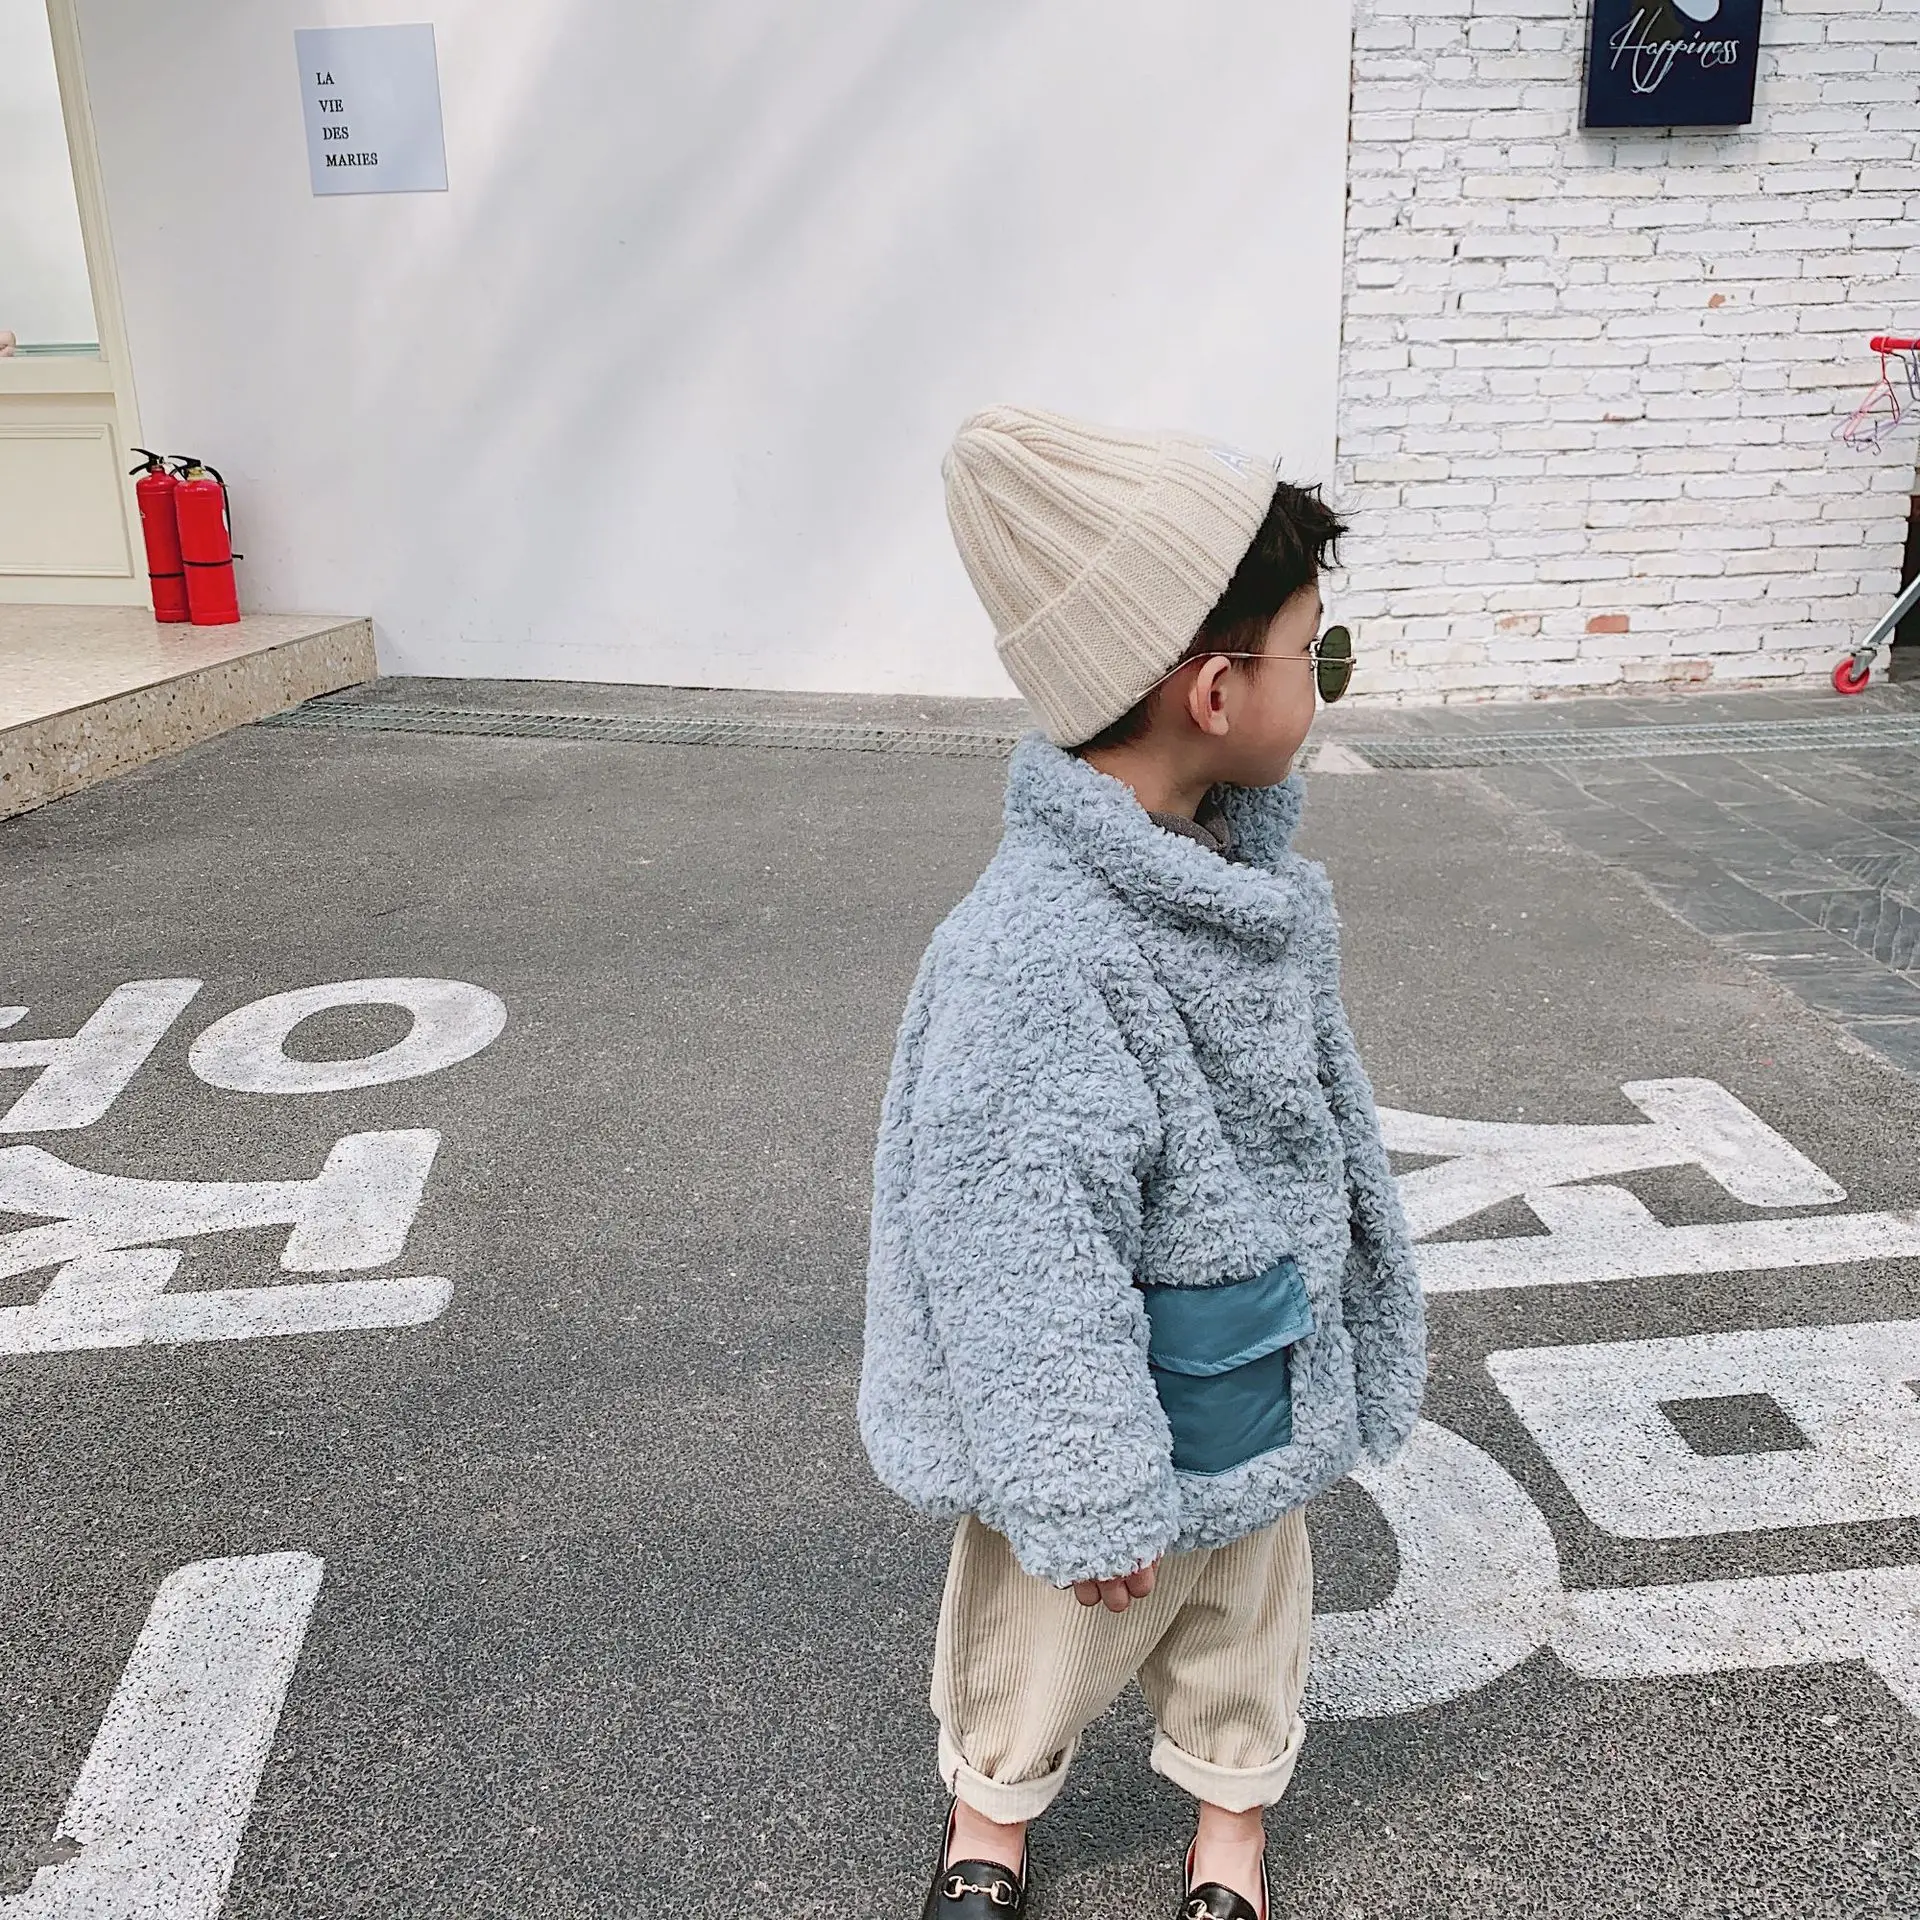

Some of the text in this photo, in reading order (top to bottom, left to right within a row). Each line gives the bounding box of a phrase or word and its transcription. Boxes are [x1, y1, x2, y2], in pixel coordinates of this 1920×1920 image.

[1609, 8, 1740, 93] Happiness
[316, 72, 335, 85] LA
[318, 99, 344, 113] VIE
[322, 126, 349, 140] DES
[325, 152, 378, 167] MARIES
